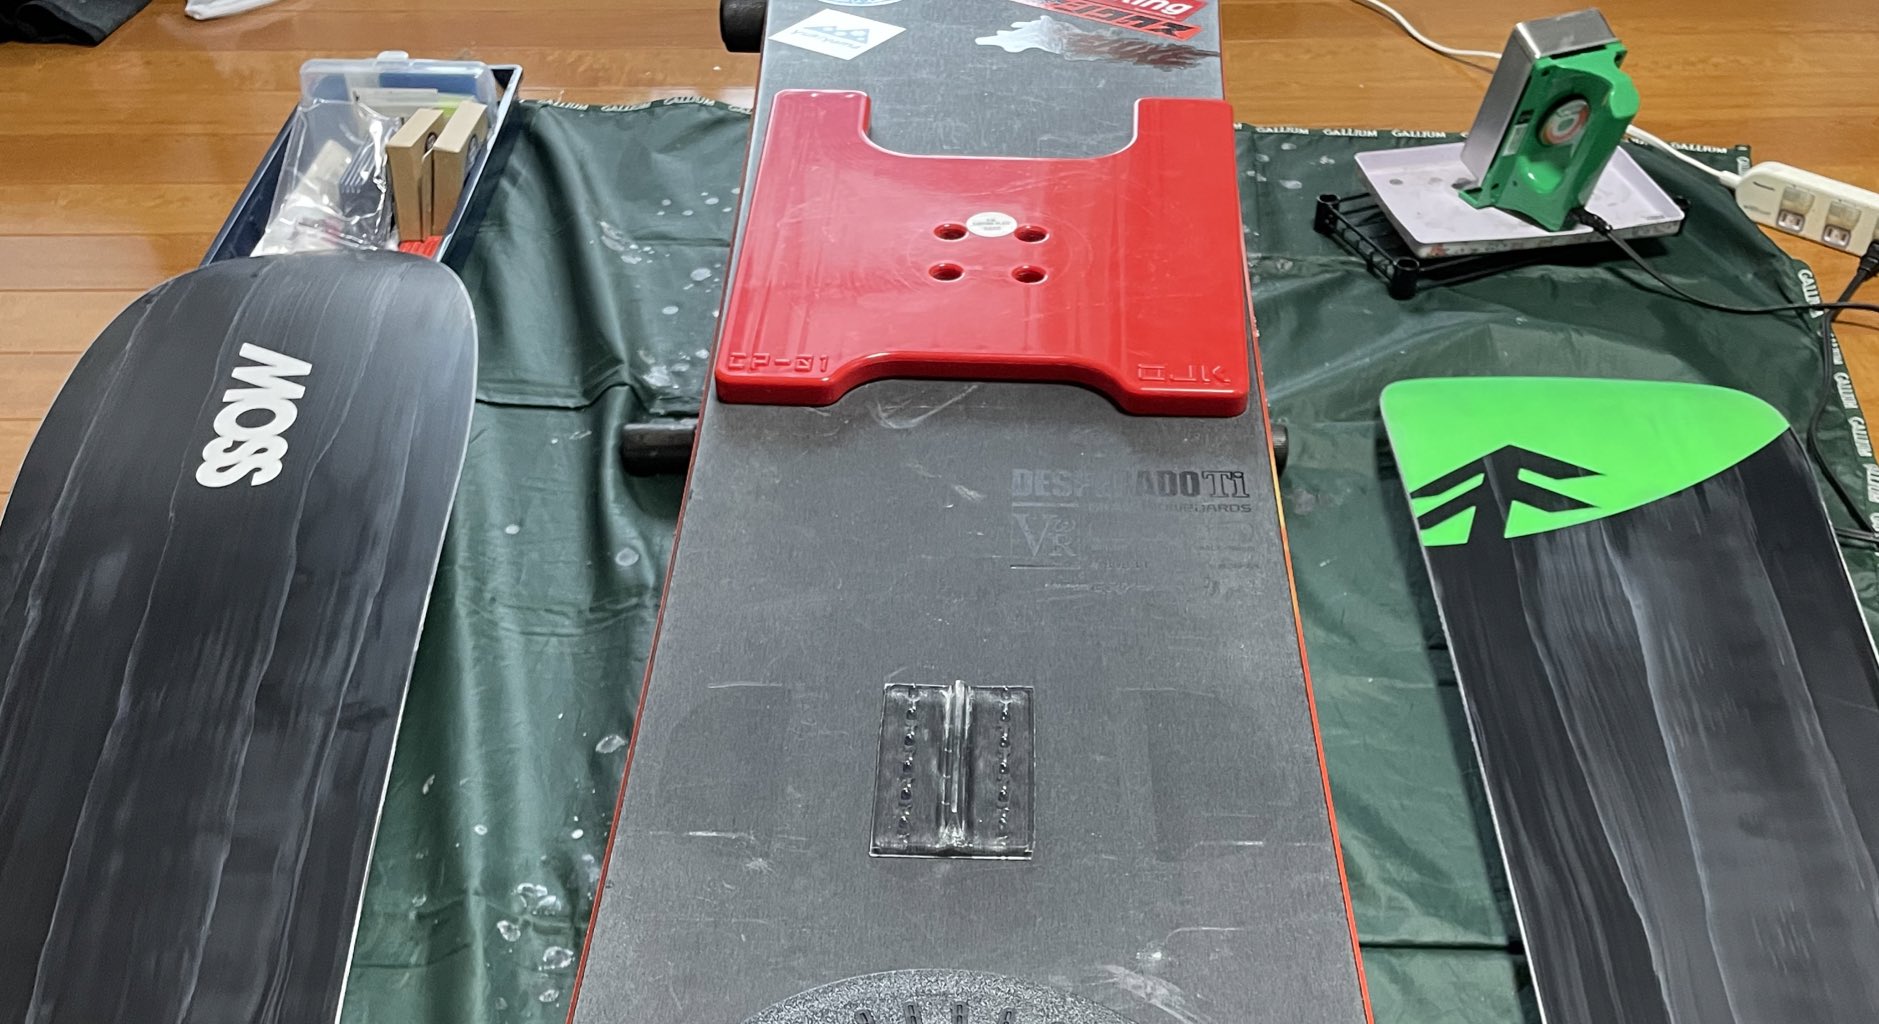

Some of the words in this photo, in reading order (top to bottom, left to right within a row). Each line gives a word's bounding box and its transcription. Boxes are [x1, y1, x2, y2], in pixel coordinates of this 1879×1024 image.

[1255, 126, 1309, 135] GALLIUM
[1322, 127, 1378, 138] GALLIUM
[1391, 129, 1446, 139] GALLIUM
[196, 342, 313, 488] MOSS
